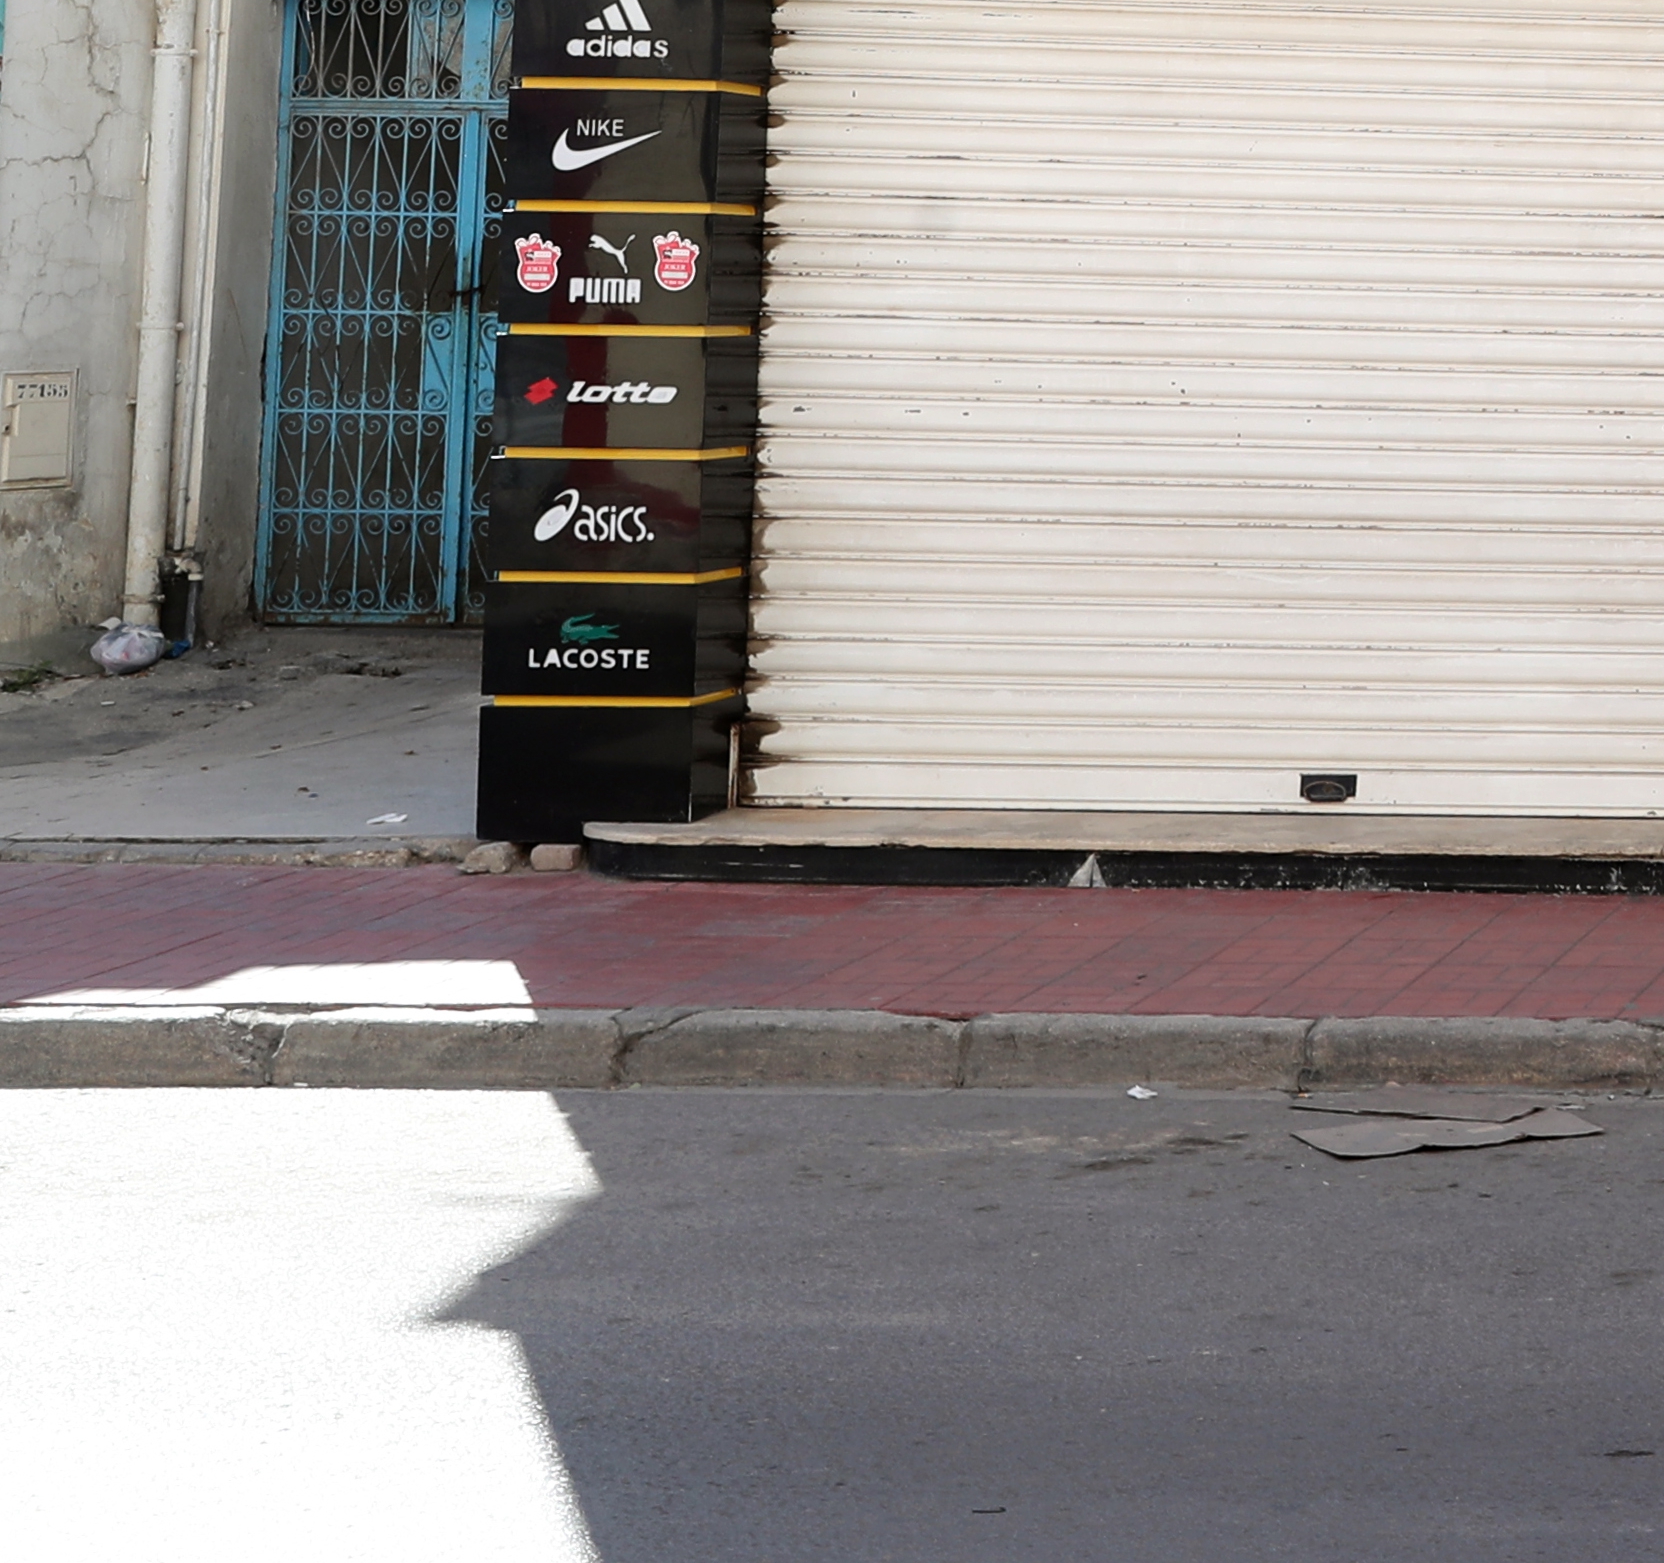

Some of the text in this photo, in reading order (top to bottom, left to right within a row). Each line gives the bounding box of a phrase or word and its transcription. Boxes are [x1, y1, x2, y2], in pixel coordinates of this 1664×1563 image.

[566, 35, 669, 58] adidas
[576, 118, 624, 137] NIKE
[568, 277, 642, 304] PUMA
[566, 380, 678, 404] lotto
[528, 648, 650, 669] LACOSTE
